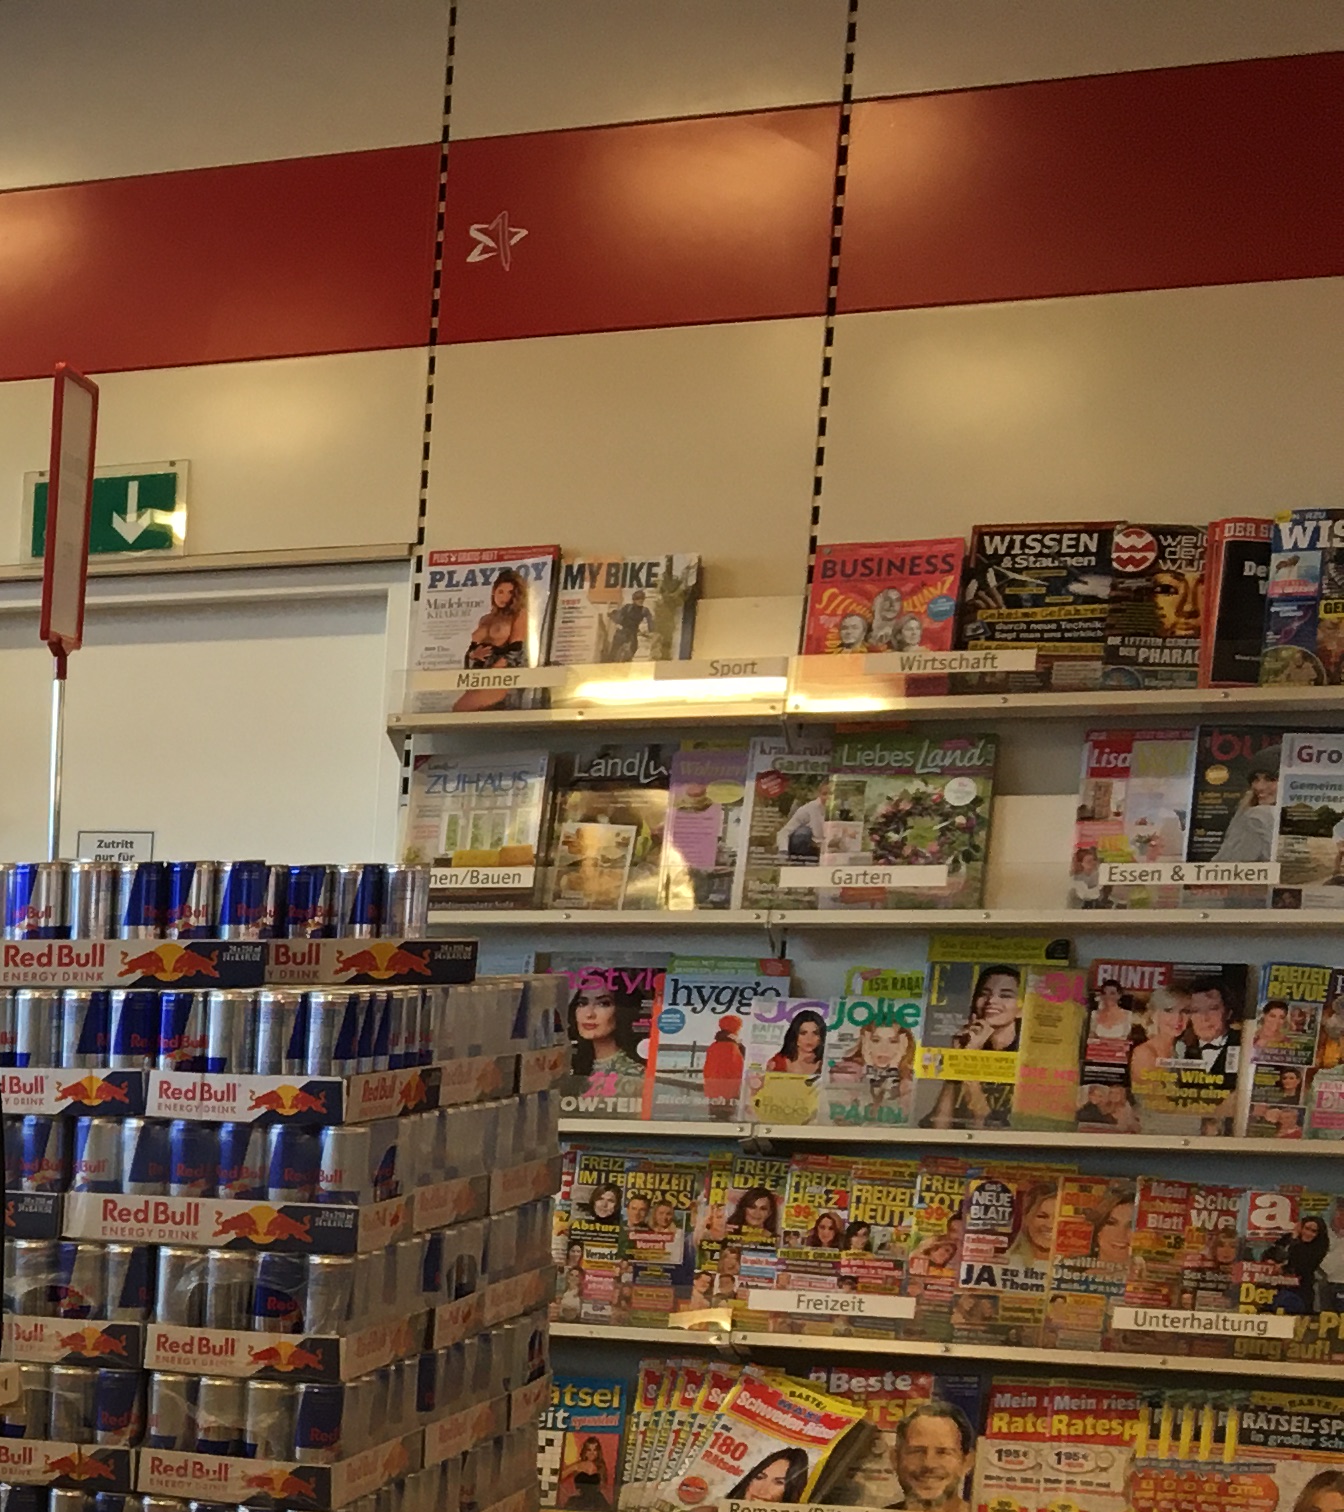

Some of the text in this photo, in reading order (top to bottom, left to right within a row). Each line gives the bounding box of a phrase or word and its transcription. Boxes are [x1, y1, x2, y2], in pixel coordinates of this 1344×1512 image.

[984, 533, 1098, 555] WISSEN
[564, 561, 661, 589] MY BIKE
[820, 553, 955, 579] BUSINESS
[708, 660, 758, 680] Sport
[899, 653, 999, 671] Wirtschaft
[457, 673, 520, 688] Männer
[97, 840, 134, 849] Zutritt
[831, 868, 892, 885] Garten
[1108, 864, 1269, 883] Essen & Trinken
[3, 942, 106, 969] Red Bull
[2, 969, 106, 984] ENERGY DRINK
[827, 996, 922, 1030] jolie
[158, 1080, 238, 1104] Red Bull
[157, 1102, 238, 1115] ENERGY DRINK
[627, 1172, 693, 1190] FREIZEIT
[102, 1199, 200, 1228] Red Bull
[101, 1226, 200, 1241] ENERGY DRINK
[796, 1294, 865, 1313] Freizeit
[1133, 1310, 1269, 1335] Unterhaltung
[155, 1333, 237, 1358] Red Bull
[830, 1372, 912, 1392] Beste
[994, 1393, 1037, 1408] Mein
[1053, 1395, 1096, 1411] Mein
[709, 1430, 749, 1461] 180
